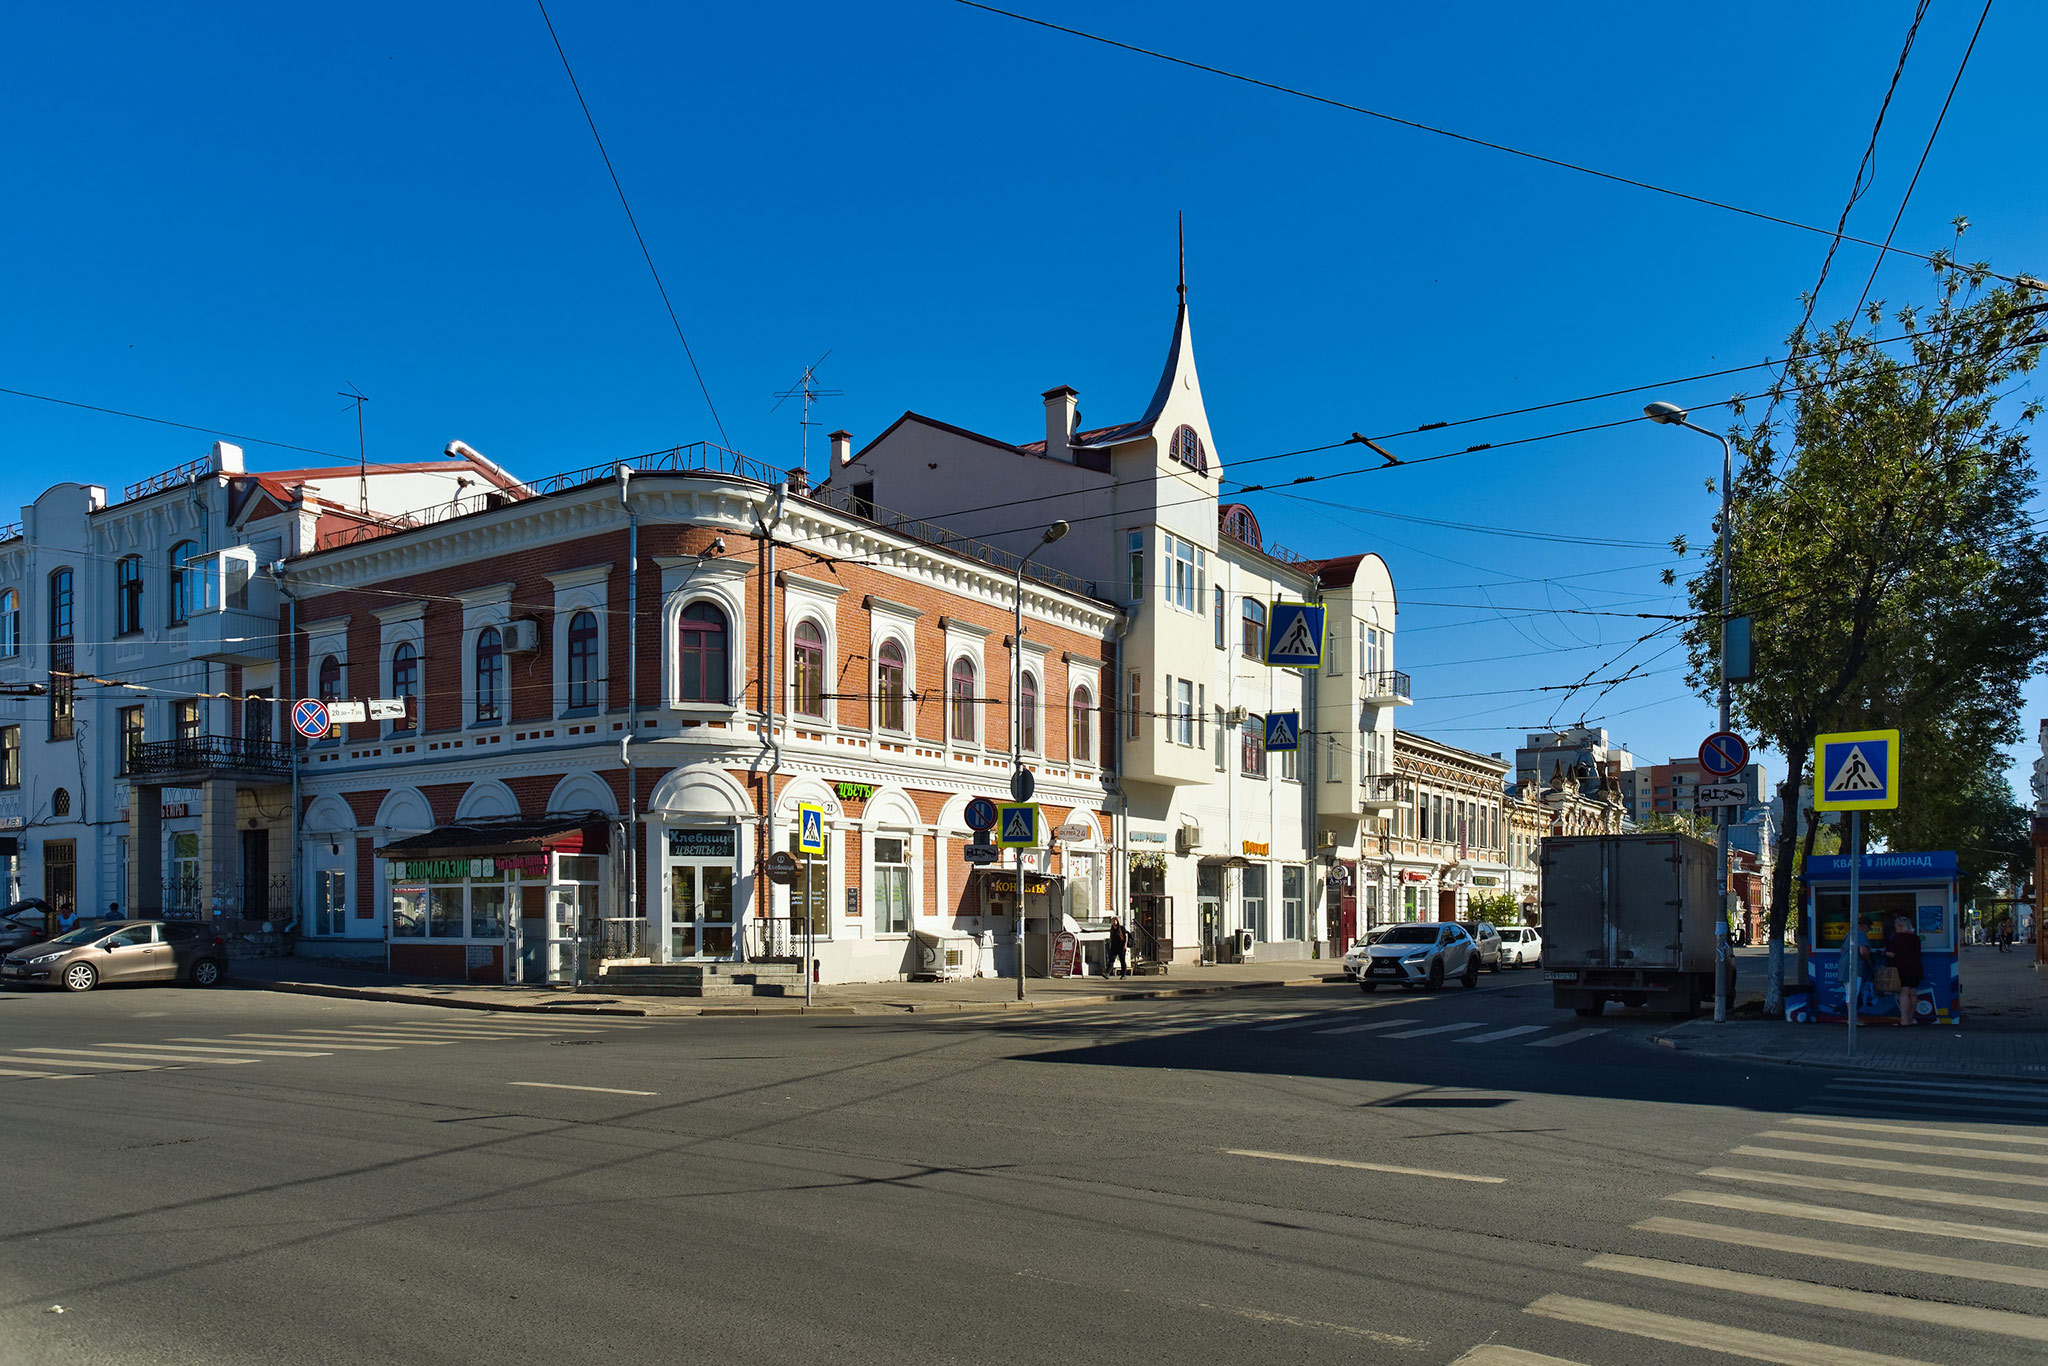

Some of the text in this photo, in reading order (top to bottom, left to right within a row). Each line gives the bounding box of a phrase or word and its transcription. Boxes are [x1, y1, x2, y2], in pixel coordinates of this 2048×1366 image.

[839, 782, 874, 798] ЦВЕТЫ
[827, 803, 834, 812] 71
[1077, 828, 1086, 837] 24
[675, 845, 728, 856] ЦВЕТЫ 24
[1875, 856, 1932, 868] ЛИМОНАД
[406, 860, 470, 879] ЗООМАГАЗИН
[995, 881, 1046, 894] КОНЕТЫ
